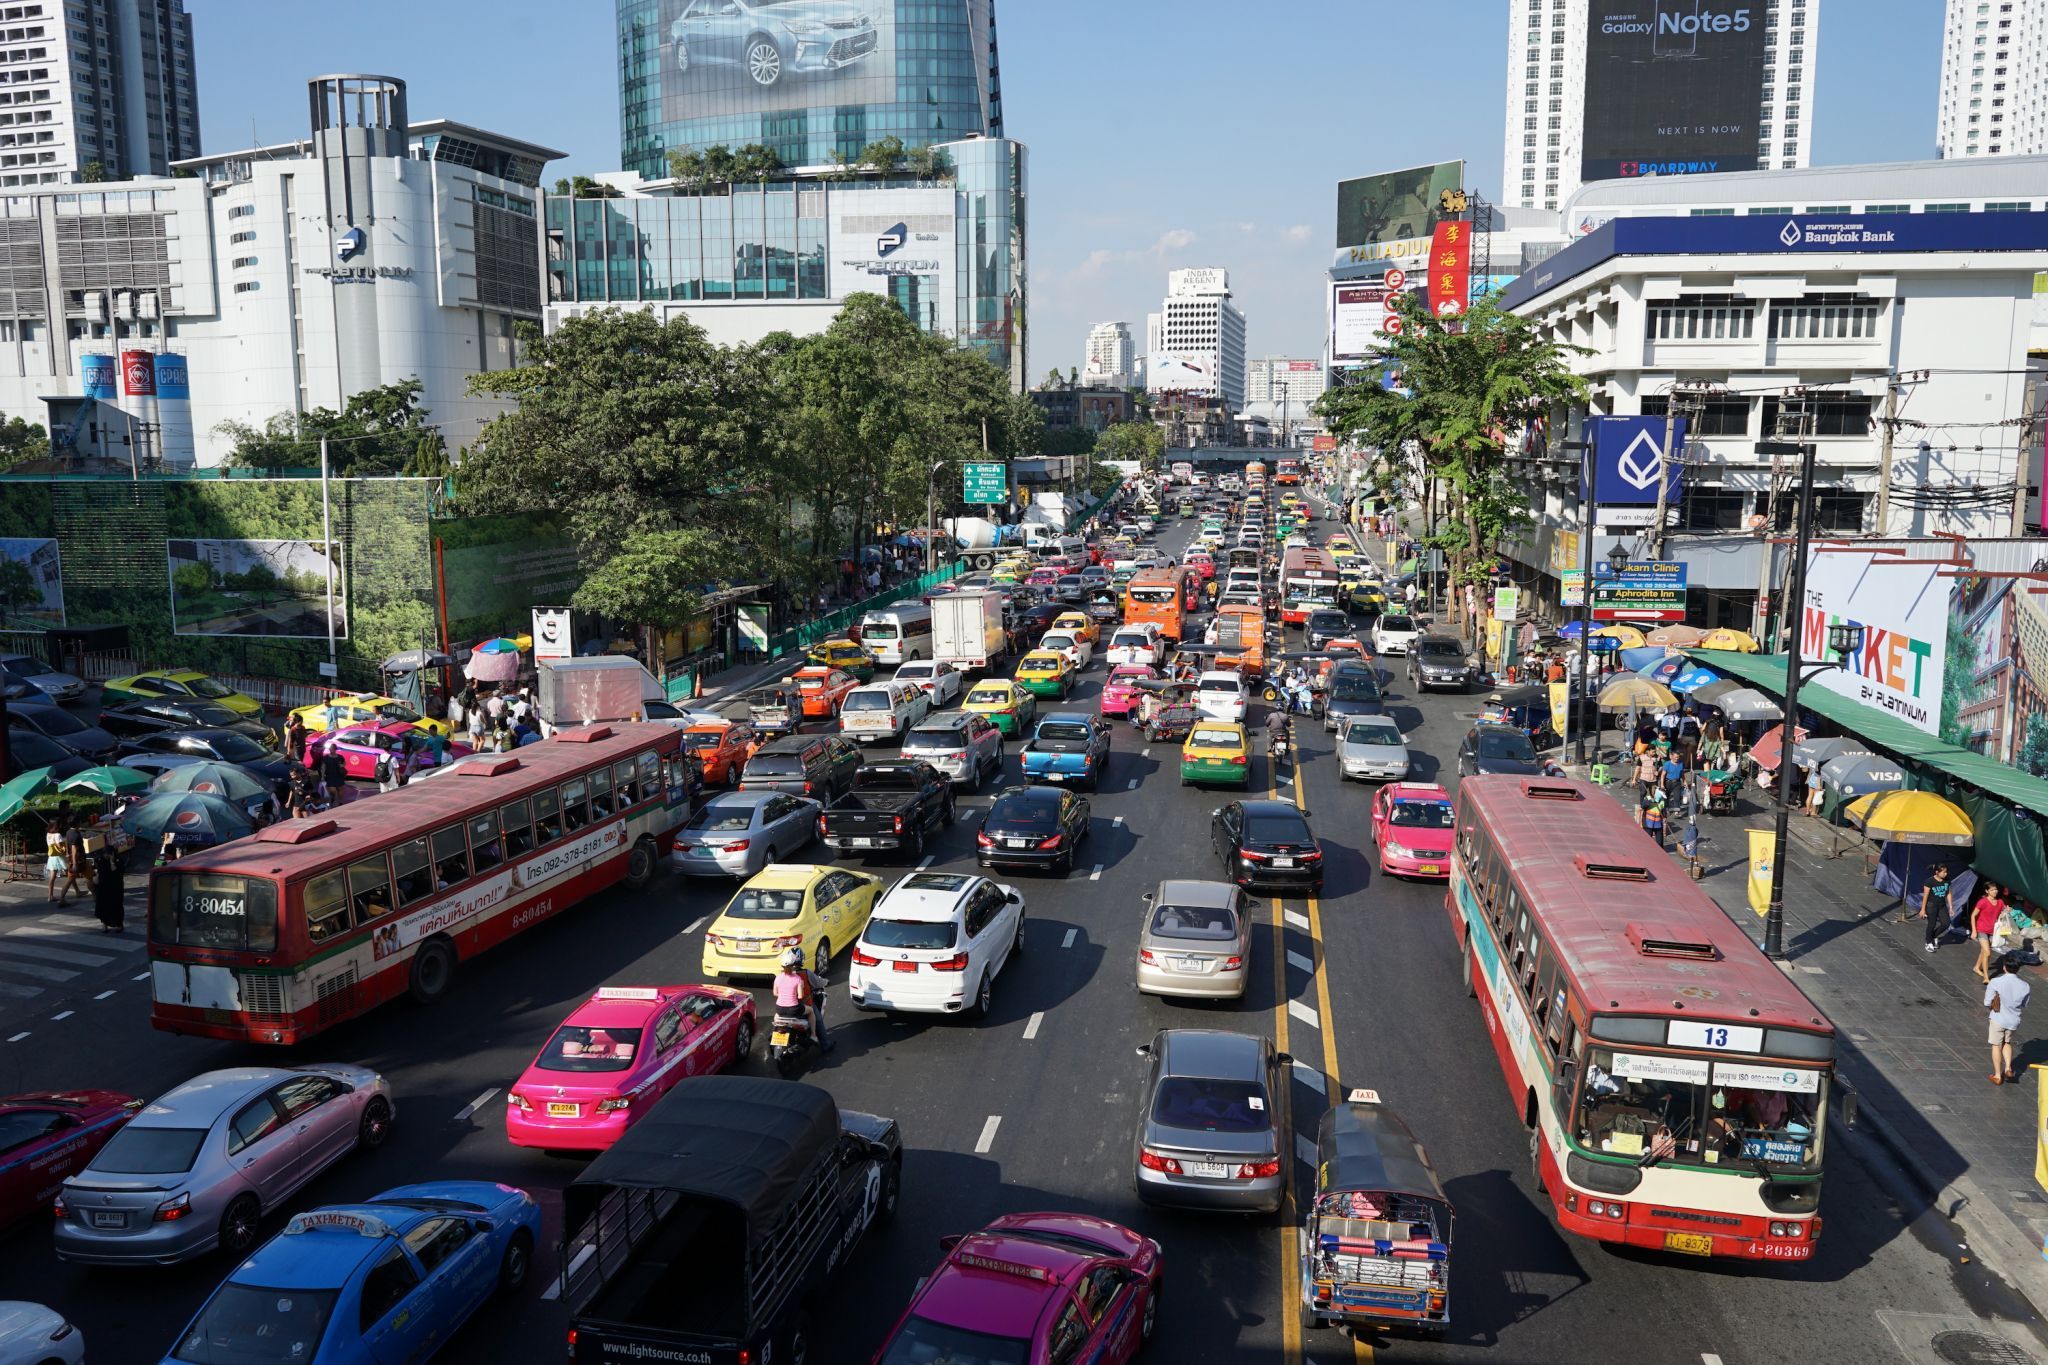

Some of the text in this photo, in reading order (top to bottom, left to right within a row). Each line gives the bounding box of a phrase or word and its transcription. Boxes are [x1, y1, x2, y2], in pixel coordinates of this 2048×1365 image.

[1602, 9, 1750, 35] Galaxy Note5
[1658, 125, 1740, 135] NEXT IS NOW
[1639, 161, 1718, 174] BOARDWAY
[1805, 230, 1895, 244] Bangkok Bank
[1187, 270, 1214, 278] INDRA
[86, 368, 113, 384] CPAC
[160, 368, 186, 384] CPAC
[1652, 563, 1680, 573] Clinic
[1615, 589, 1658, 598] Aphrodite
[1806, 589, 1824, 608] THE
[398, 655, 418, 664] VISA
[1803, 606, 1932, 699] MARKET
[1868, 771, 1903, 781] VISA
[184, 895, 246, 916] 8-80454
[512, 897, 552, 929] 8-80454
[1704, 1027, 1728, 1047] 13
[1738, 1073, 1749, 1081] ISO
[1356, 1091, 1375, 1099] TAXI
[300, 1213, 366, 1231] TAXI-METER
[602, 1341, 712, 1365] www.lightsource.co.th
